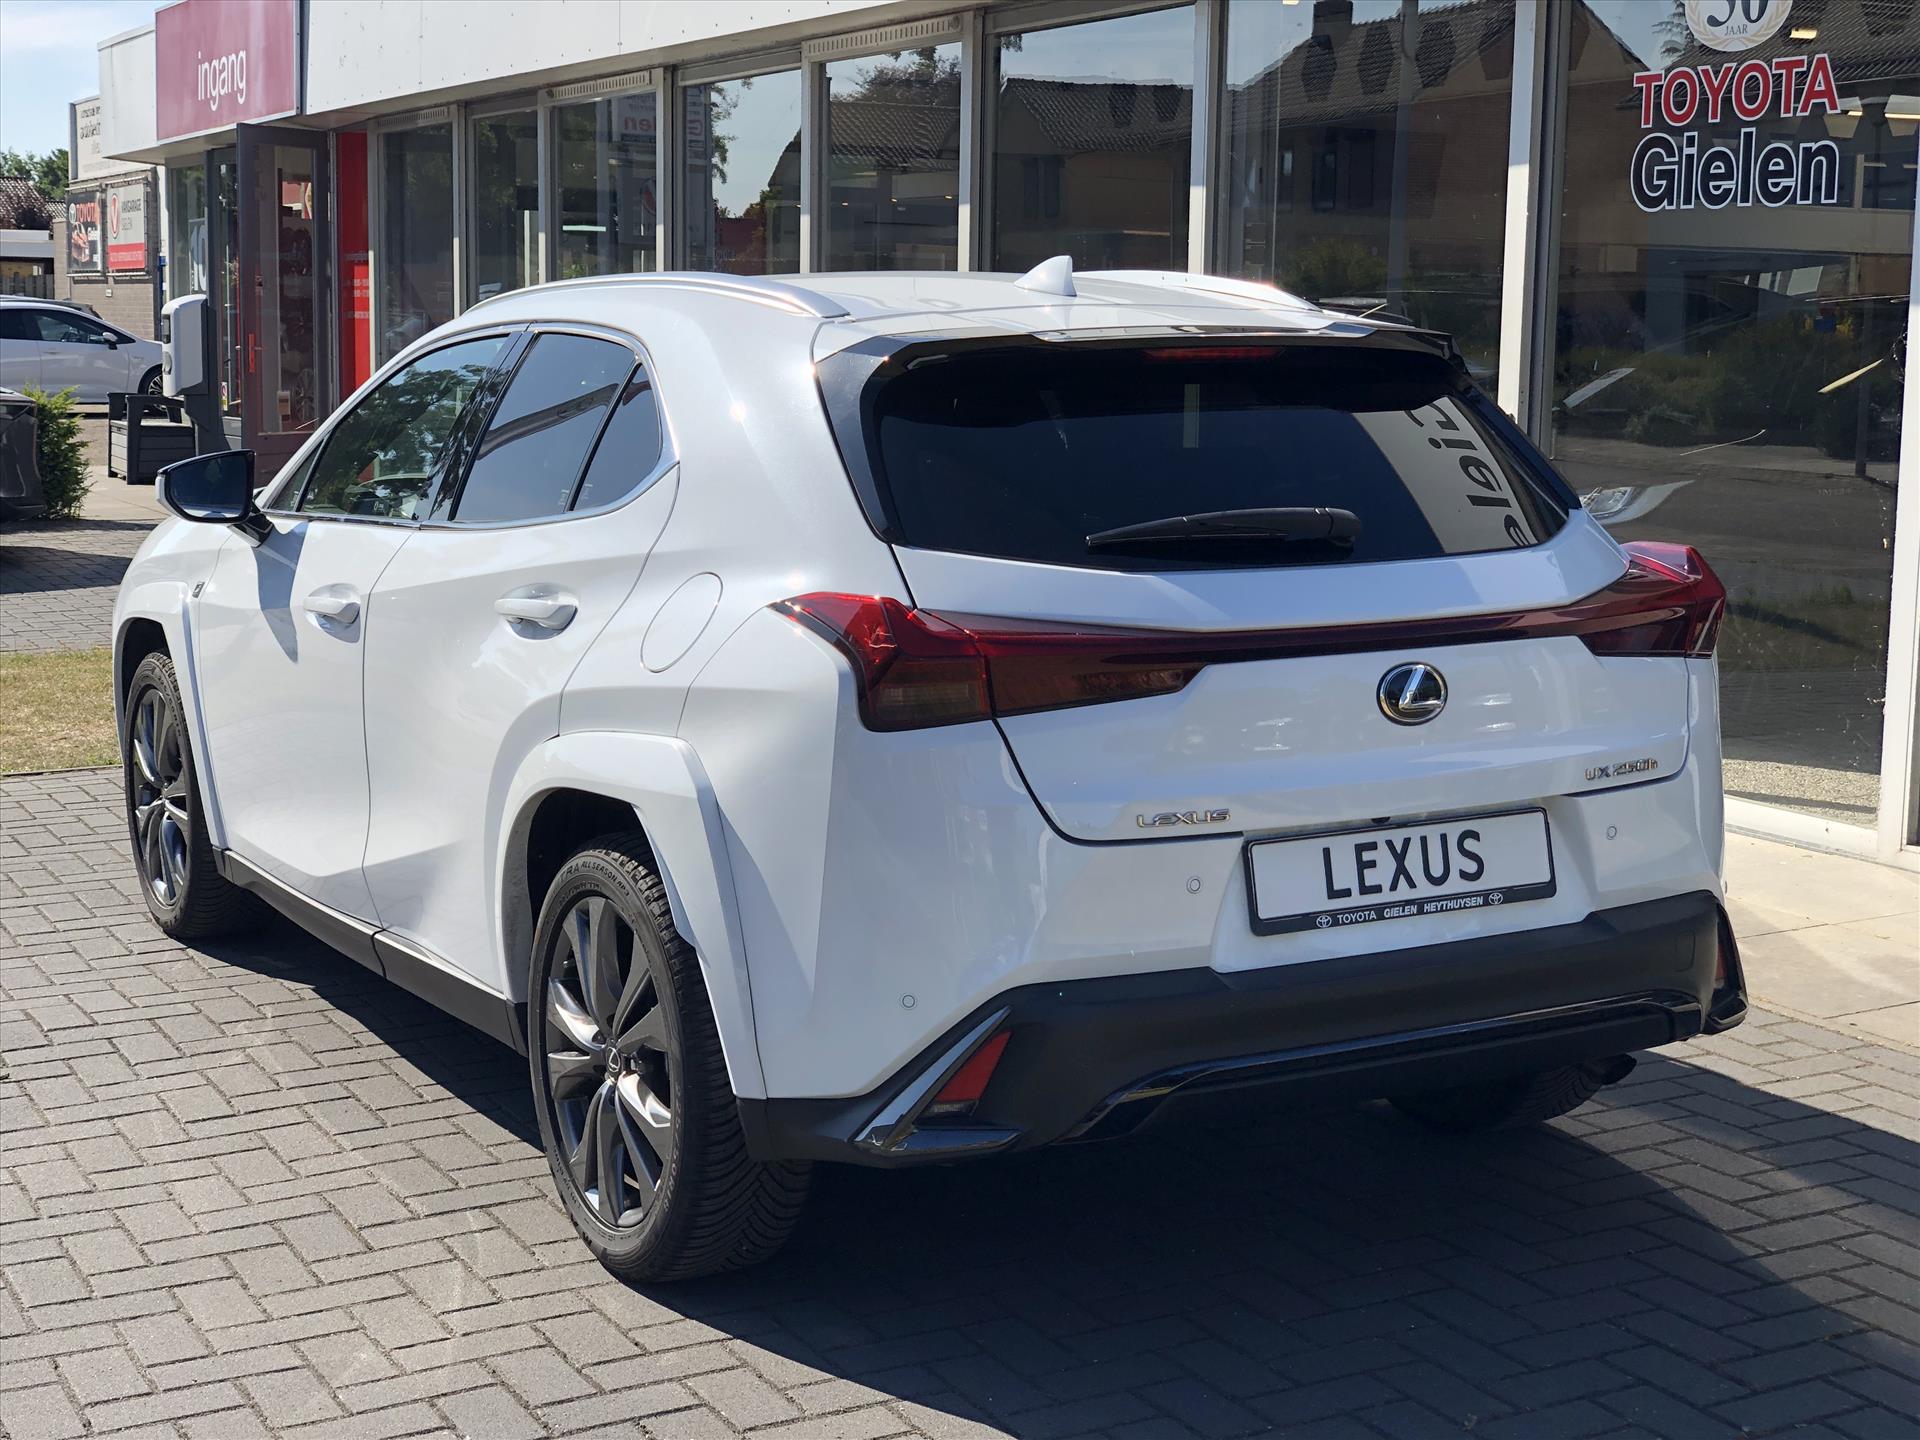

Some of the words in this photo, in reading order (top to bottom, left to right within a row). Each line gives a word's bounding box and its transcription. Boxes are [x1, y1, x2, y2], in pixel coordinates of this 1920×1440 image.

[1724, 24, 1748, 36] JAAR
[198, 49, 246, 111] ingang
[1633, 53, 1841, 128] TOYOTA
[1630, 127, 1840, 213] Gielen
[1584, 766, 1611, 781] UX
[1612, 757, 1658, 776] 250h
[1136, 808, 1231, 828] LEXUS
[591, 862, 618, 882] SEASON
[1322, 829, 1485, 900] LEXUS
[1337, 910, 1377, 924] TOYOTA
[1384, 904, 1418, 918] GIELEN
[1423, 895, 1484, 914] HEYTHUYSEN
